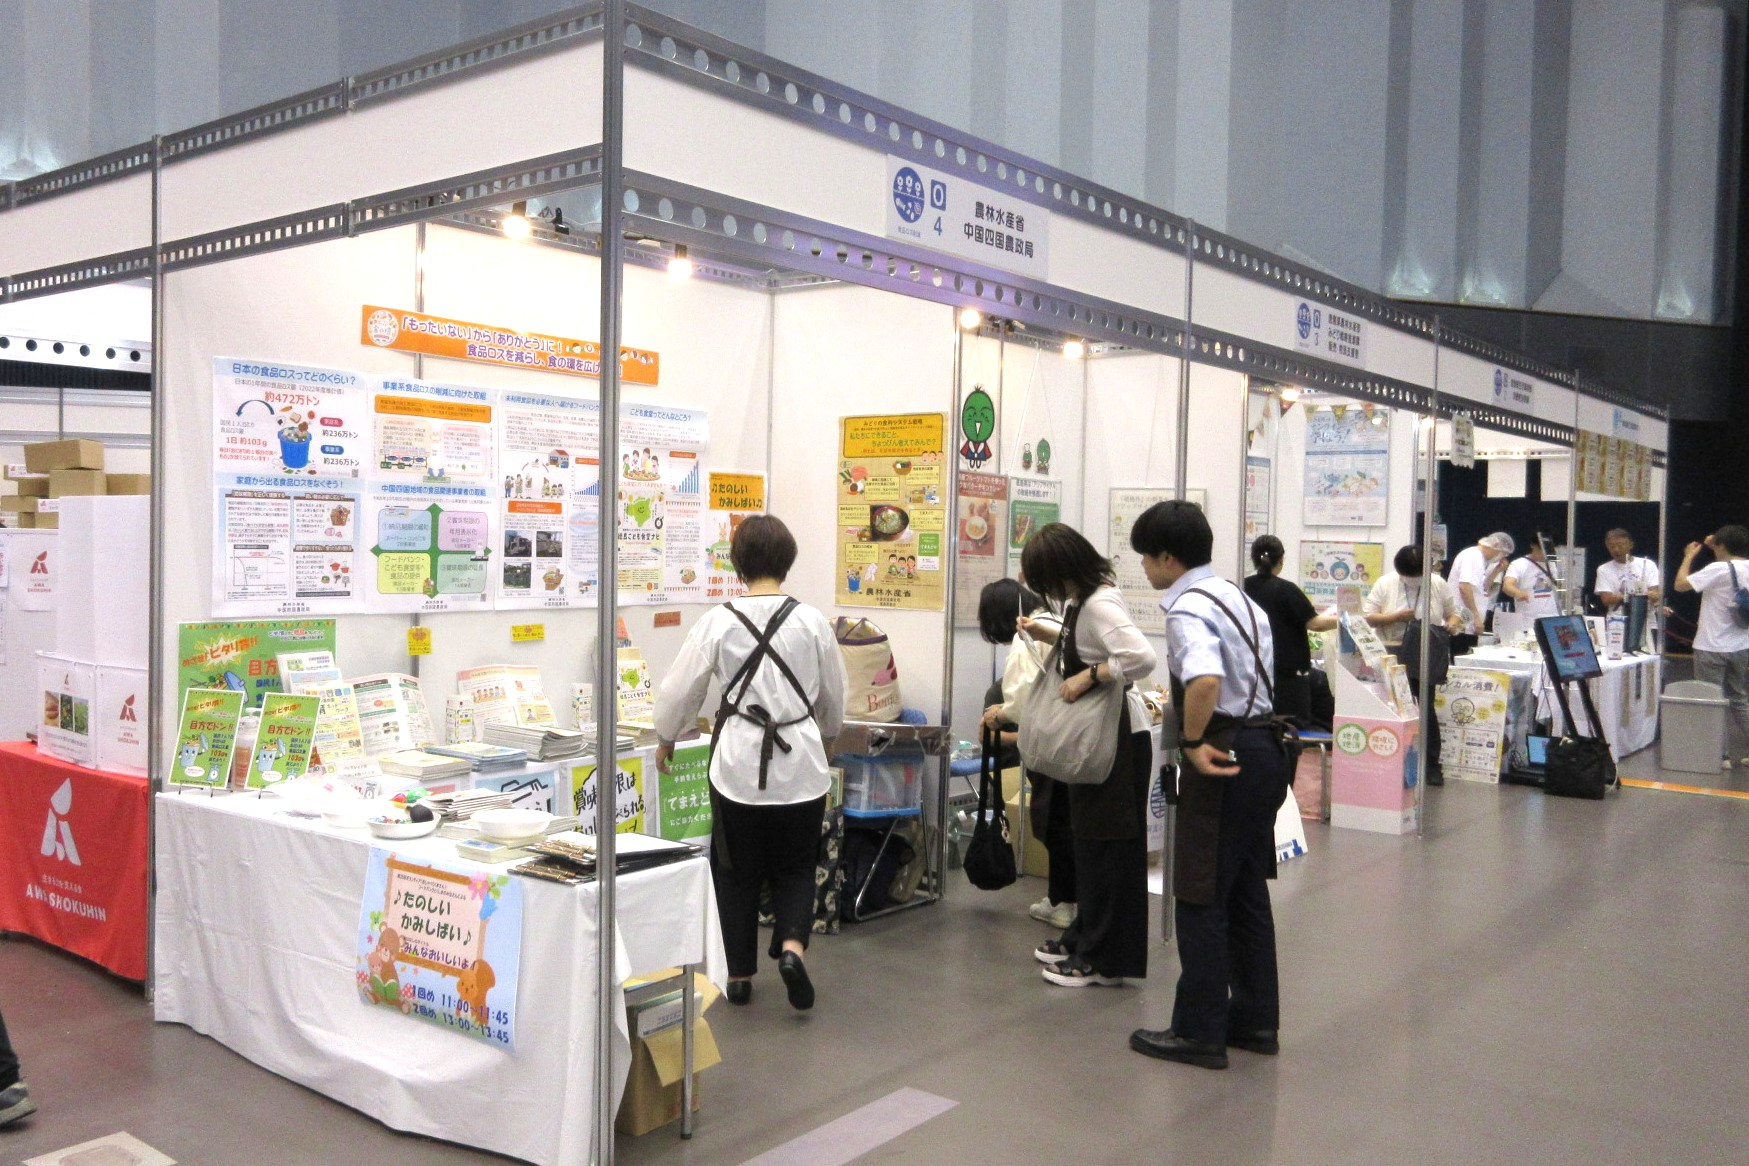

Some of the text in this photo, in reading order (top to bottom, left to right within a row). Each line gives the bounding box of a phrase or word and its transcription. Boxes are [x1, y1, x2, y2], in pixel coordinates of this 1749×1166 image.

[975, 201, 1024, 233] 農林水産省
[963, 222, 1034, 258] 中国四国農政局
[232, 362, 356, 386] 日本の食品ロスってどのくらい？
[264, 390, 320, 406] 約472万トン
[382, 380, 487, 400] 事業系食品ロスの削減に向けた取組
[322, 429, 359, 439] 約236万トン
[323, 457, 360, 467] 約236万トン
[236, 475, 344, 489] 家庭から出る食品ロスをなくそう！
[866, 587, 911, 598] 農林水産省
[49, 892, 107, 922] SHOKUHIN
[402, 891, 451, 916] たのしい
[401, 912, 461, 942] かみしばい
[412, 984, 435, 1003] 1回め
[412, 1002, 437, 1019] 2回め
